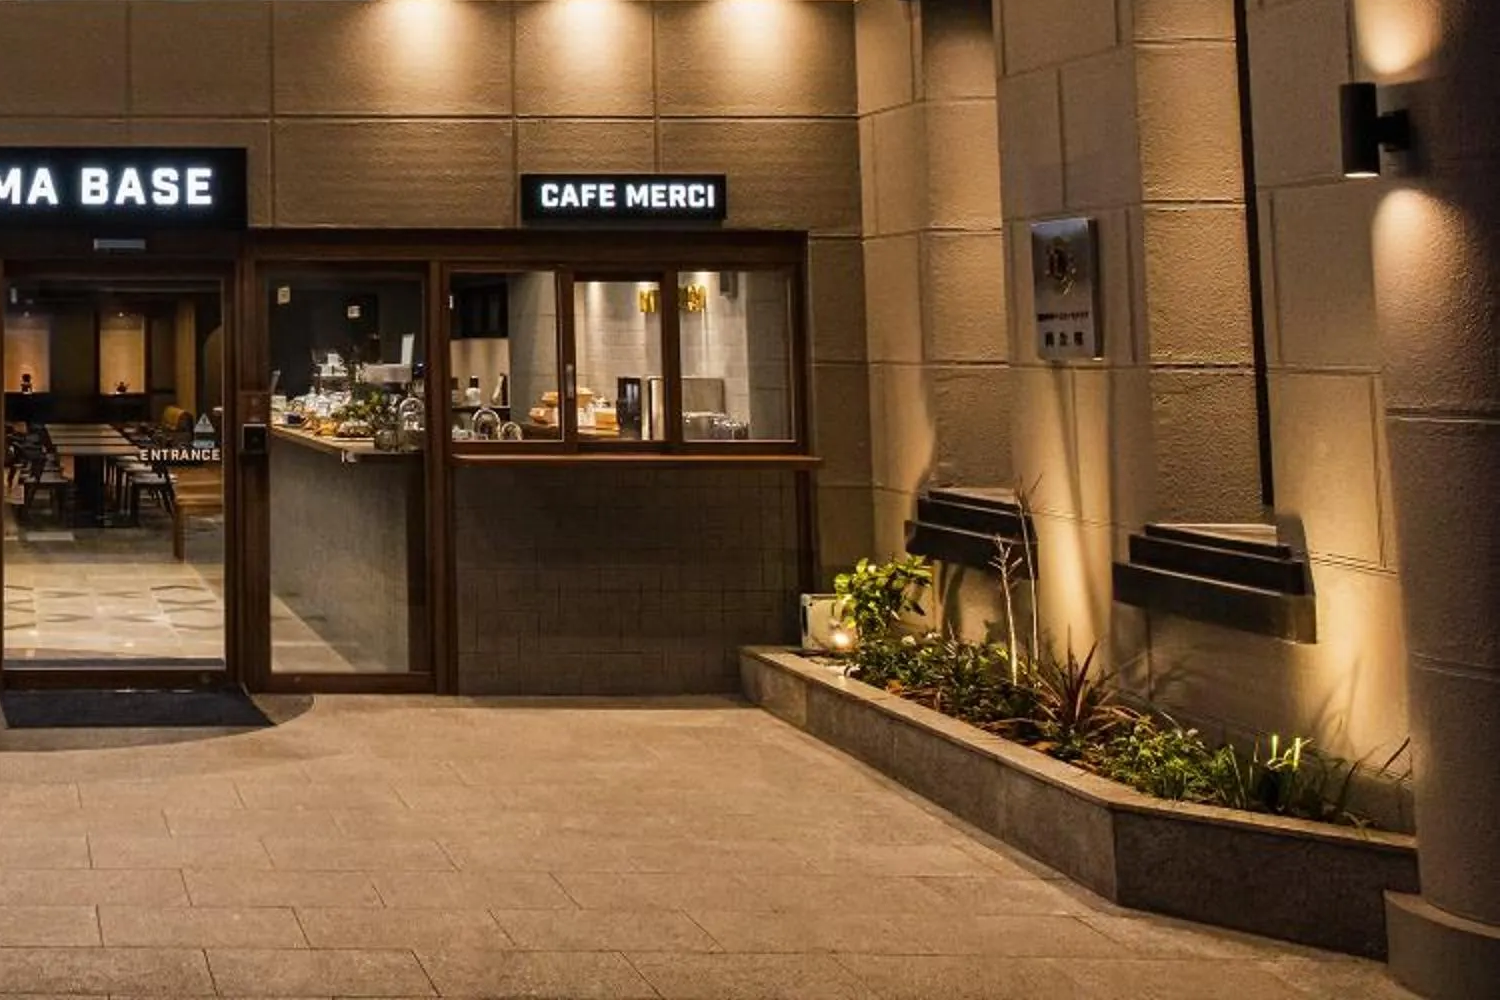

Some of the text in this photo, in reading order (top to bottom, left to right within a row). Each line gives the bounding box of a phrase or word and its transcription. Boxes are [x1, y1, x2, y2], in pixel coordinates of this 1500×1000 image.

[81, 167, 212, 205] BASE
[541, 183, 715, 208] CAFE MERCI
[139, 448, 221, 461] ENTRANCE
